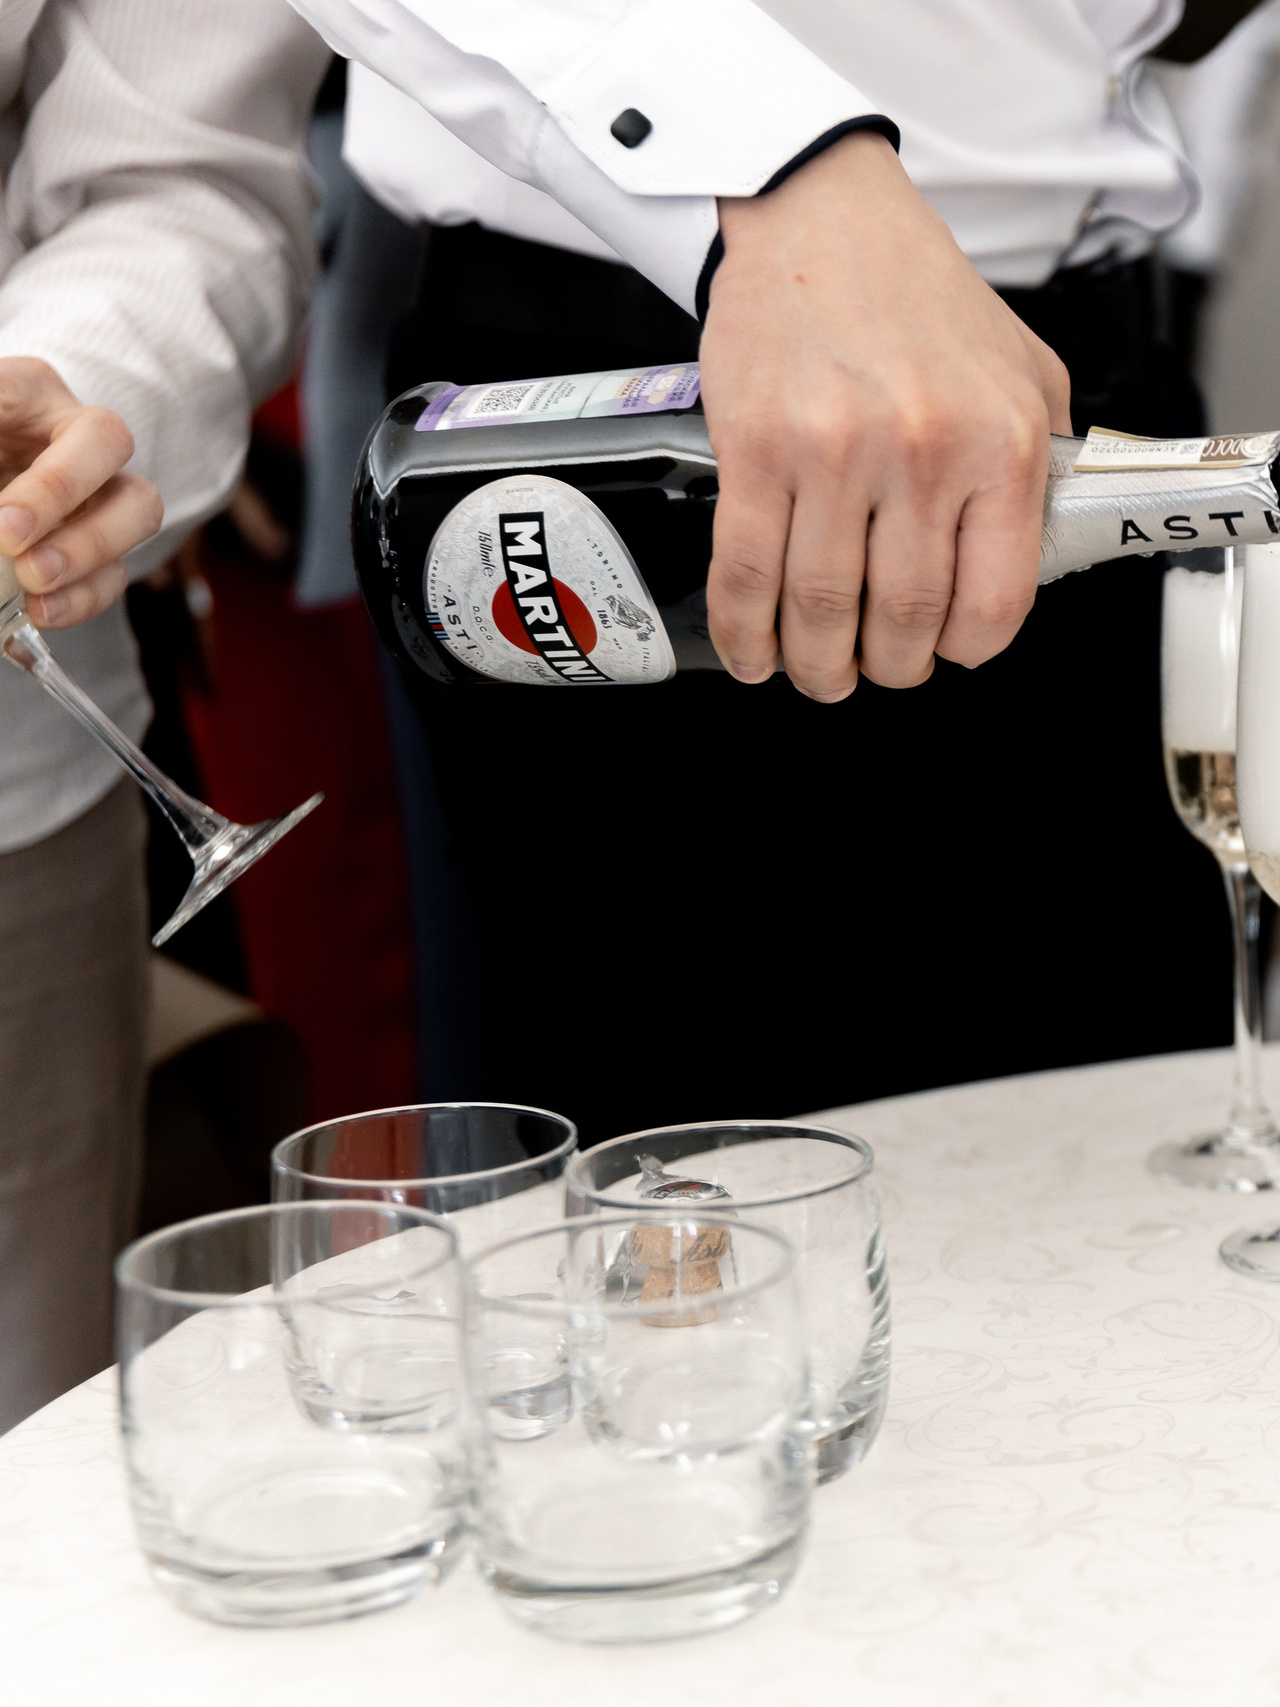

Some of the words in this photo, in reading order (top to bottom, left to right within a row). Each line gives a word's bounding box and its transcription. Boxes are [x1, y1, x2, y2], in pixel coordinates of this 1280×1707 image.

[1120, 509, 1280, 546] ASTI
[430, 559, 439, 609] PRODOTTO
[591, 542, 624, 590] TORINO
[504, 520, 607, 681] MARTINI
[596, 609, 613, 630] 1863
